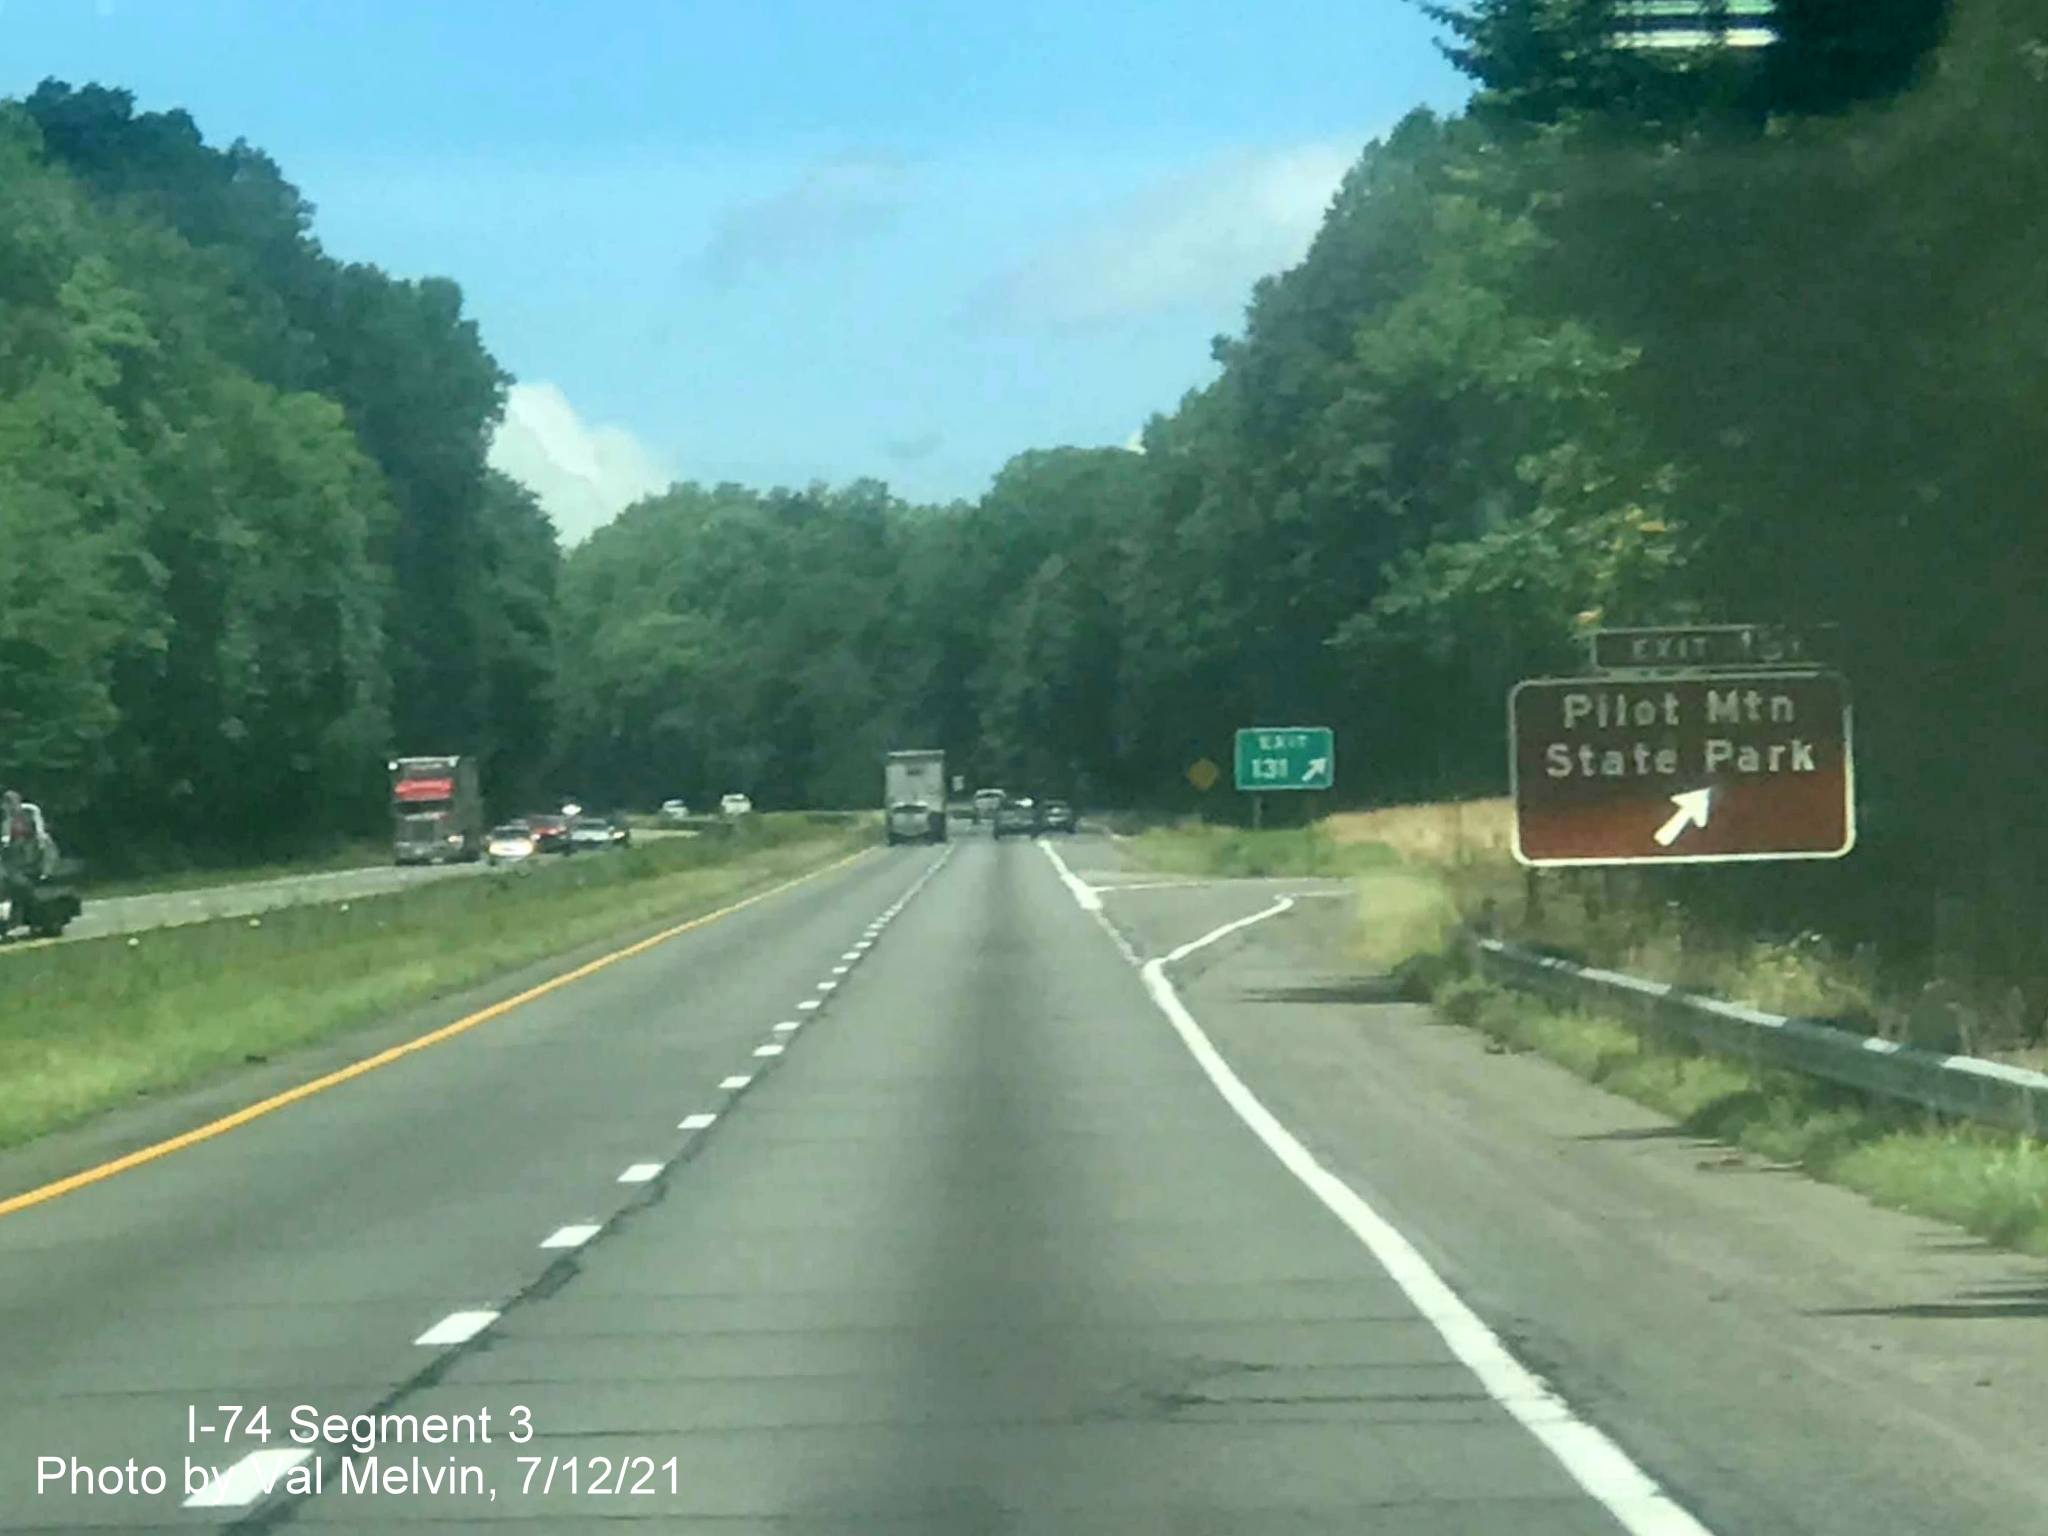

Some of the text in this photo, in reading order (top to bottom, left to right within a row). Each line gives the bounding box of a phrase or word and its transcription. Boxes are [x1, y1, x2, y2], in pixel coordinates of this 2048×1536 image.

[1632, 636, 1707, 660] EXIT
[1562, 689, 1795, 728] Pilot Mtn
[1251, 757, 1289, 779] 131
[1546, 739, 1816, 778] State Park
